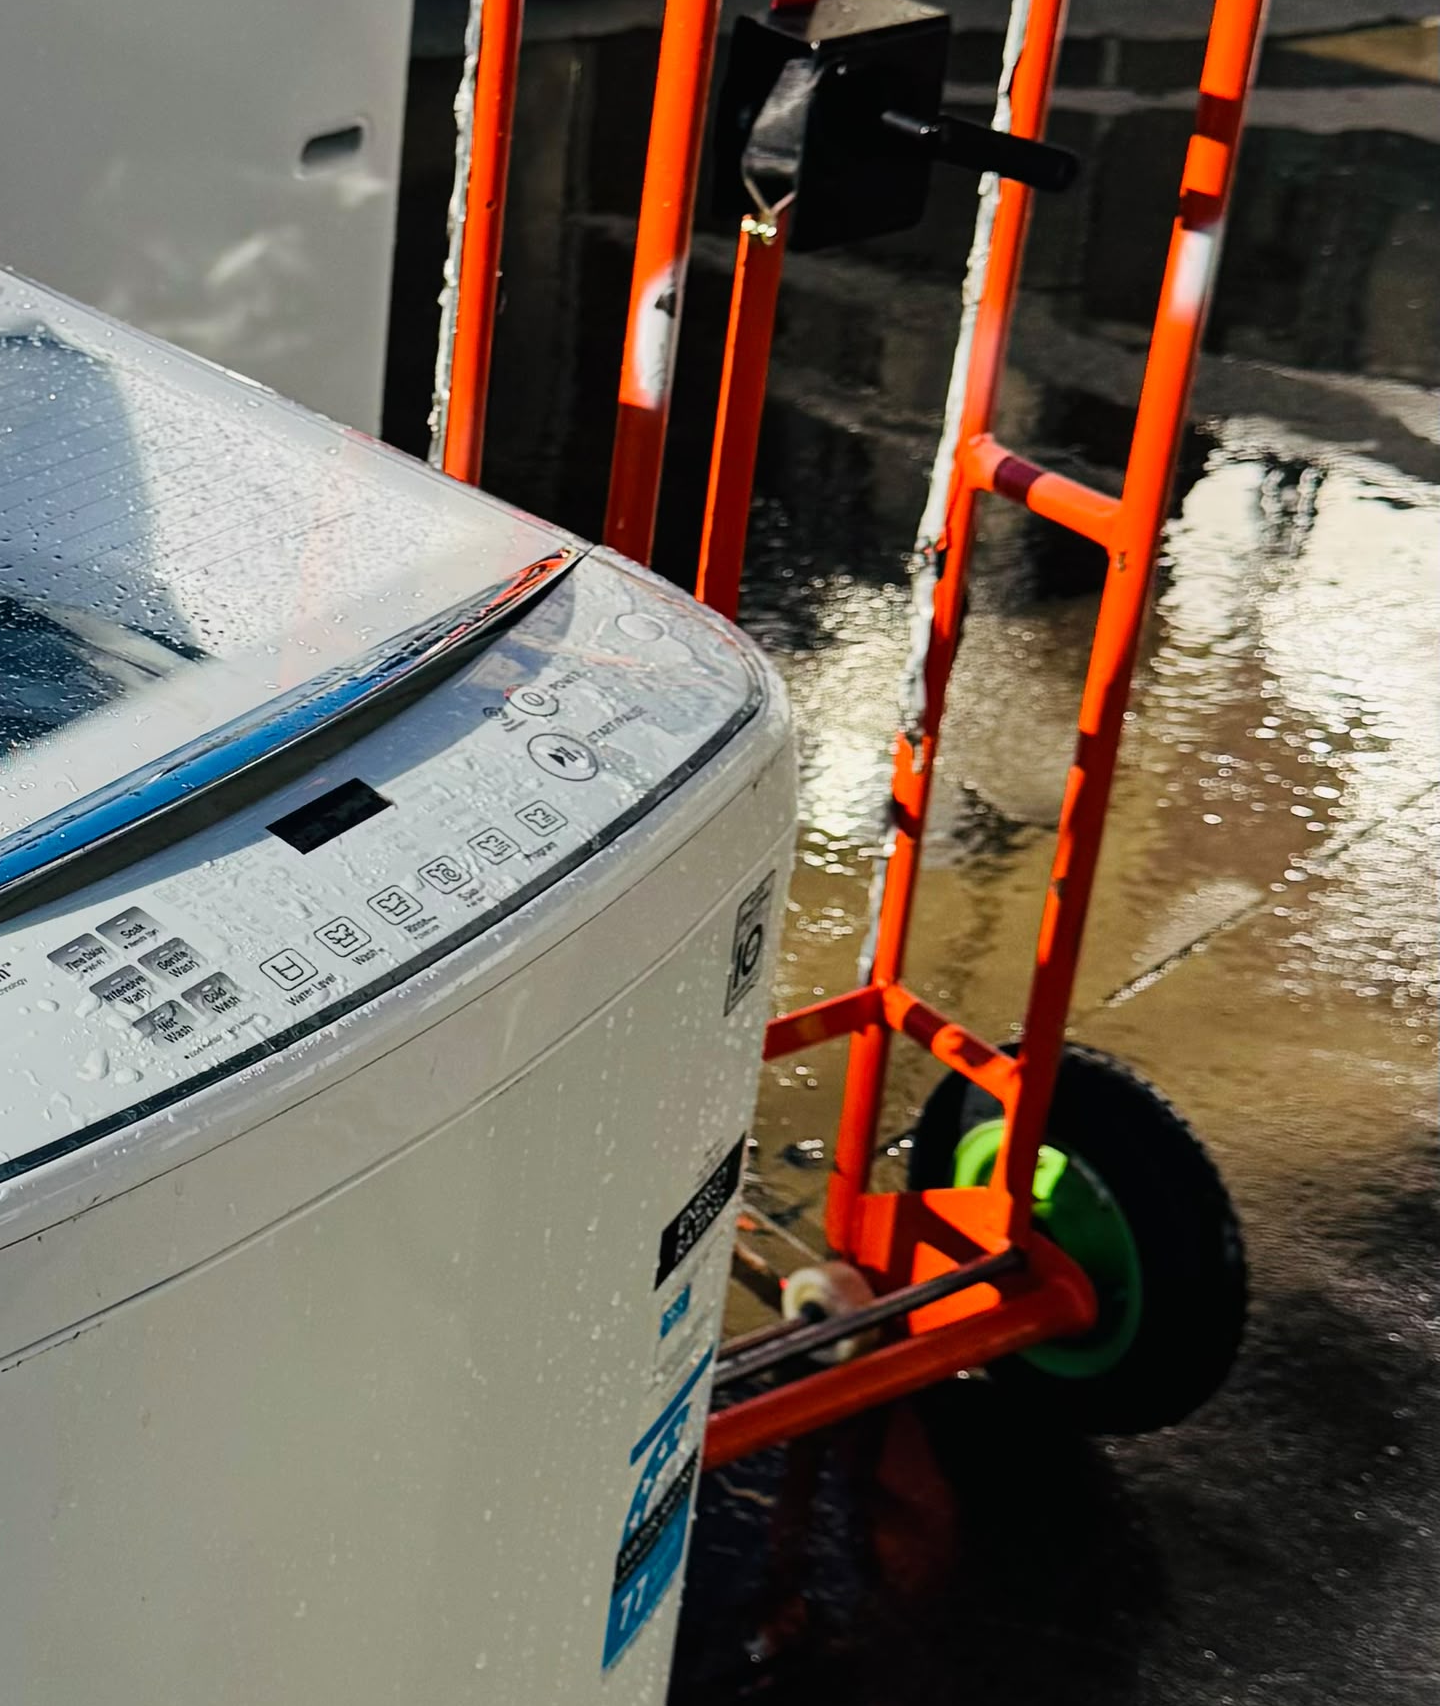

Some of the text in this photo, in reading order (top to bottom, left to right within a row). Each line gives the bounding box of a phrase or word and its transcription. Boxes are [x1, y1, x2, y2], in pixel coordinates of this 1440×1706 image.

[120, 923, 146, 939] Soak
[351, 949, 378, 966] Wash
[168, 959, 200, 978] Wash
[122, 987, 151, 1005] Wash
[203, 986, 227, 1004] Cold
[286, 973, 336, 1006] Water Level
[211, 996, 242, 1014] Wash
[163, 1024, 194, 1043] Wash
